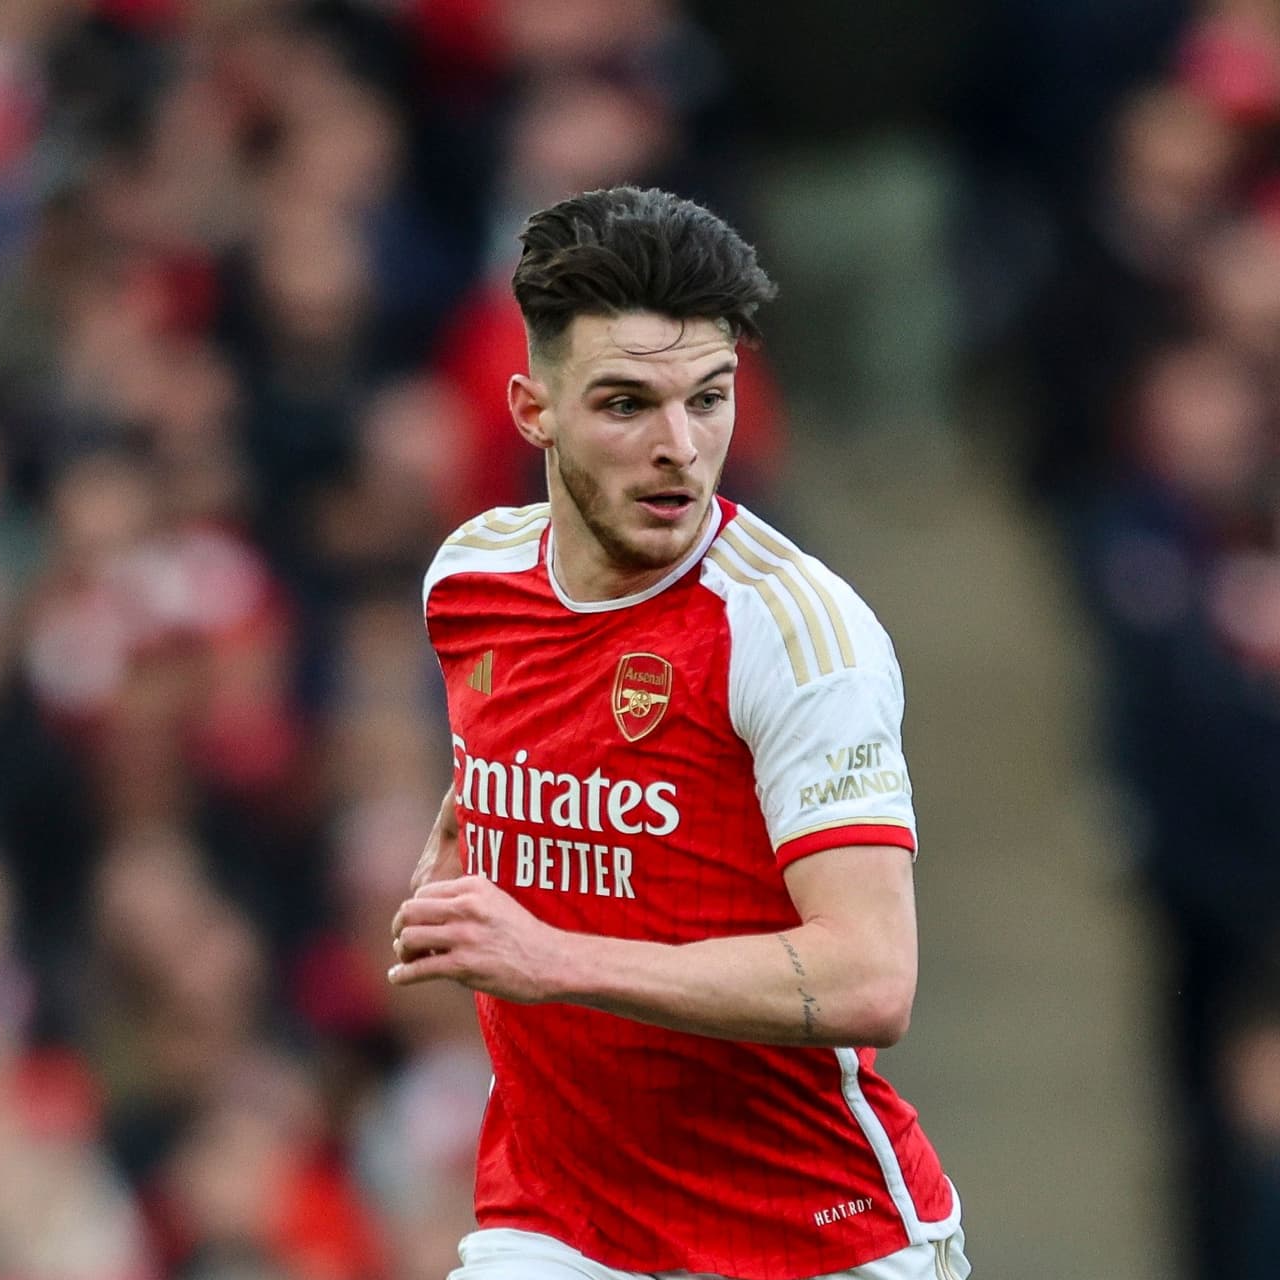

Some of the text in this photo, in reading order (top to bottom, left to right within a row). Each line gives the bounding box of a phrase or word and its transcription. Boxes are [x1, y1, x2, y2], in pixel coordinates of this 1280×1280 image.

[624, 667, 665, 686] Arsenal
[825, 742, 882, 773] VISIT
[465, 822, 636, 899] FLY BETTER
